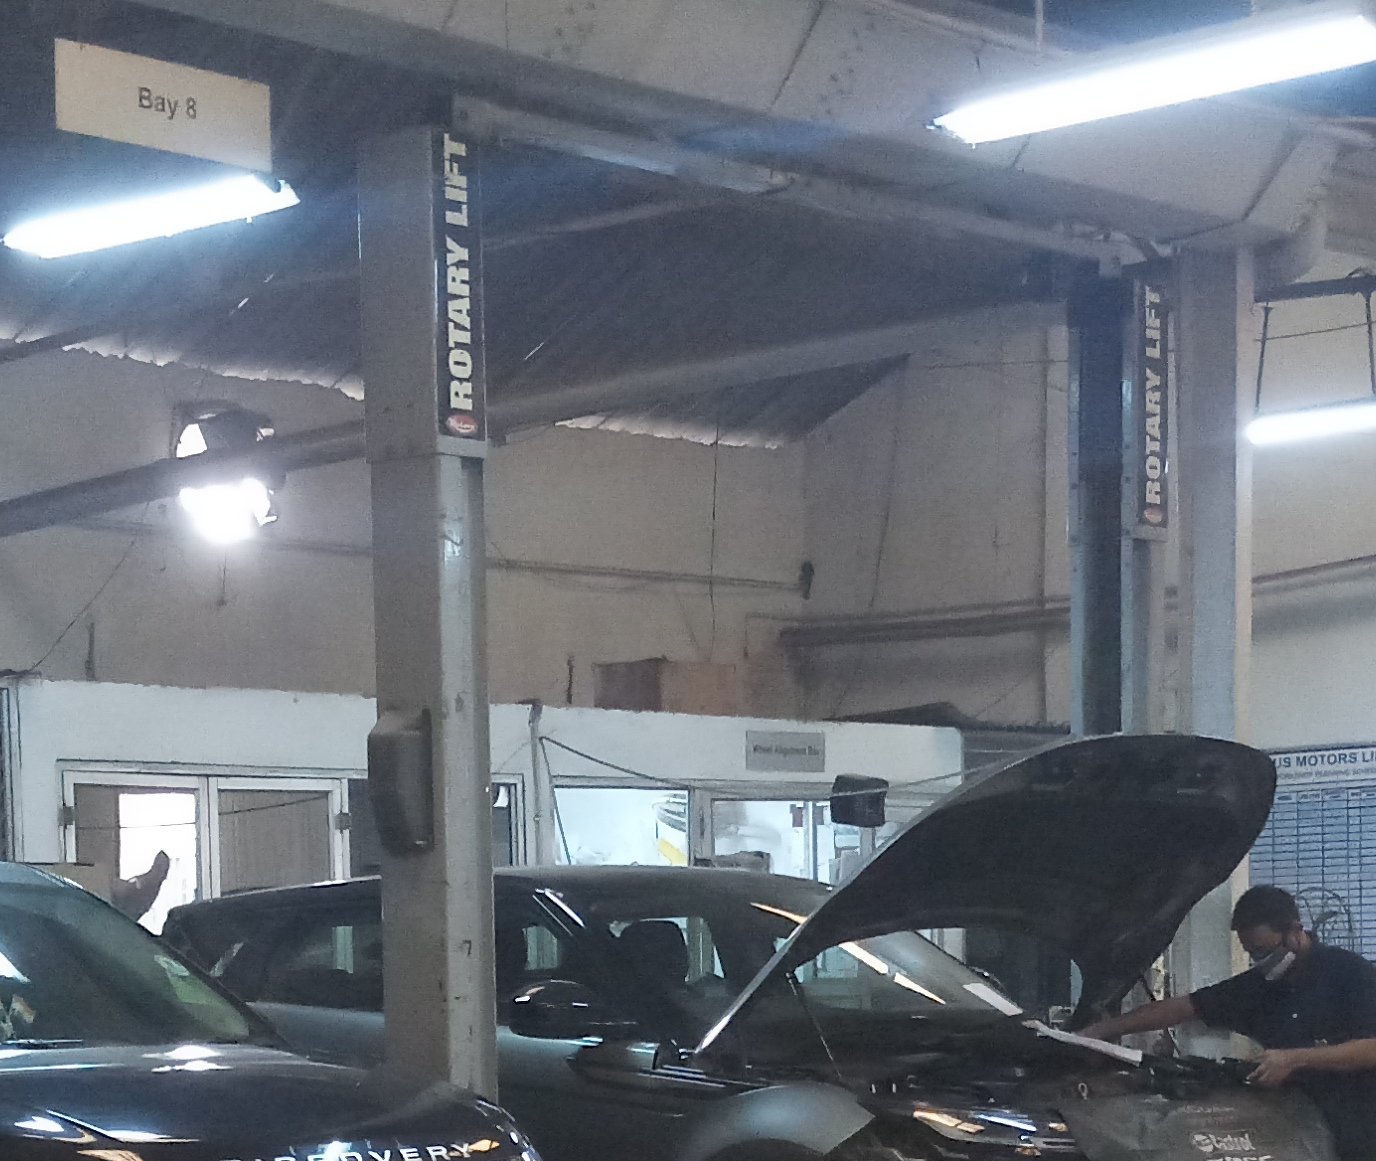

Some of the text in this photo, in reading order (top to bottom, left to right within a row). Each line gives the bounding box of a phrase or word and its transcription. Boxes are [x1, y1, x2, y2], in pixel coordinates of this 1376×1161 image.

[137, 86, 197, 120] Bay 8
[443, 132, 468, 227] LIFT
[445, 234, 473, 411] ROTARY
[1145, 285, 1161, 505] ROTARY LIFT
[1295, 749, 1359, 768] MOTORS
